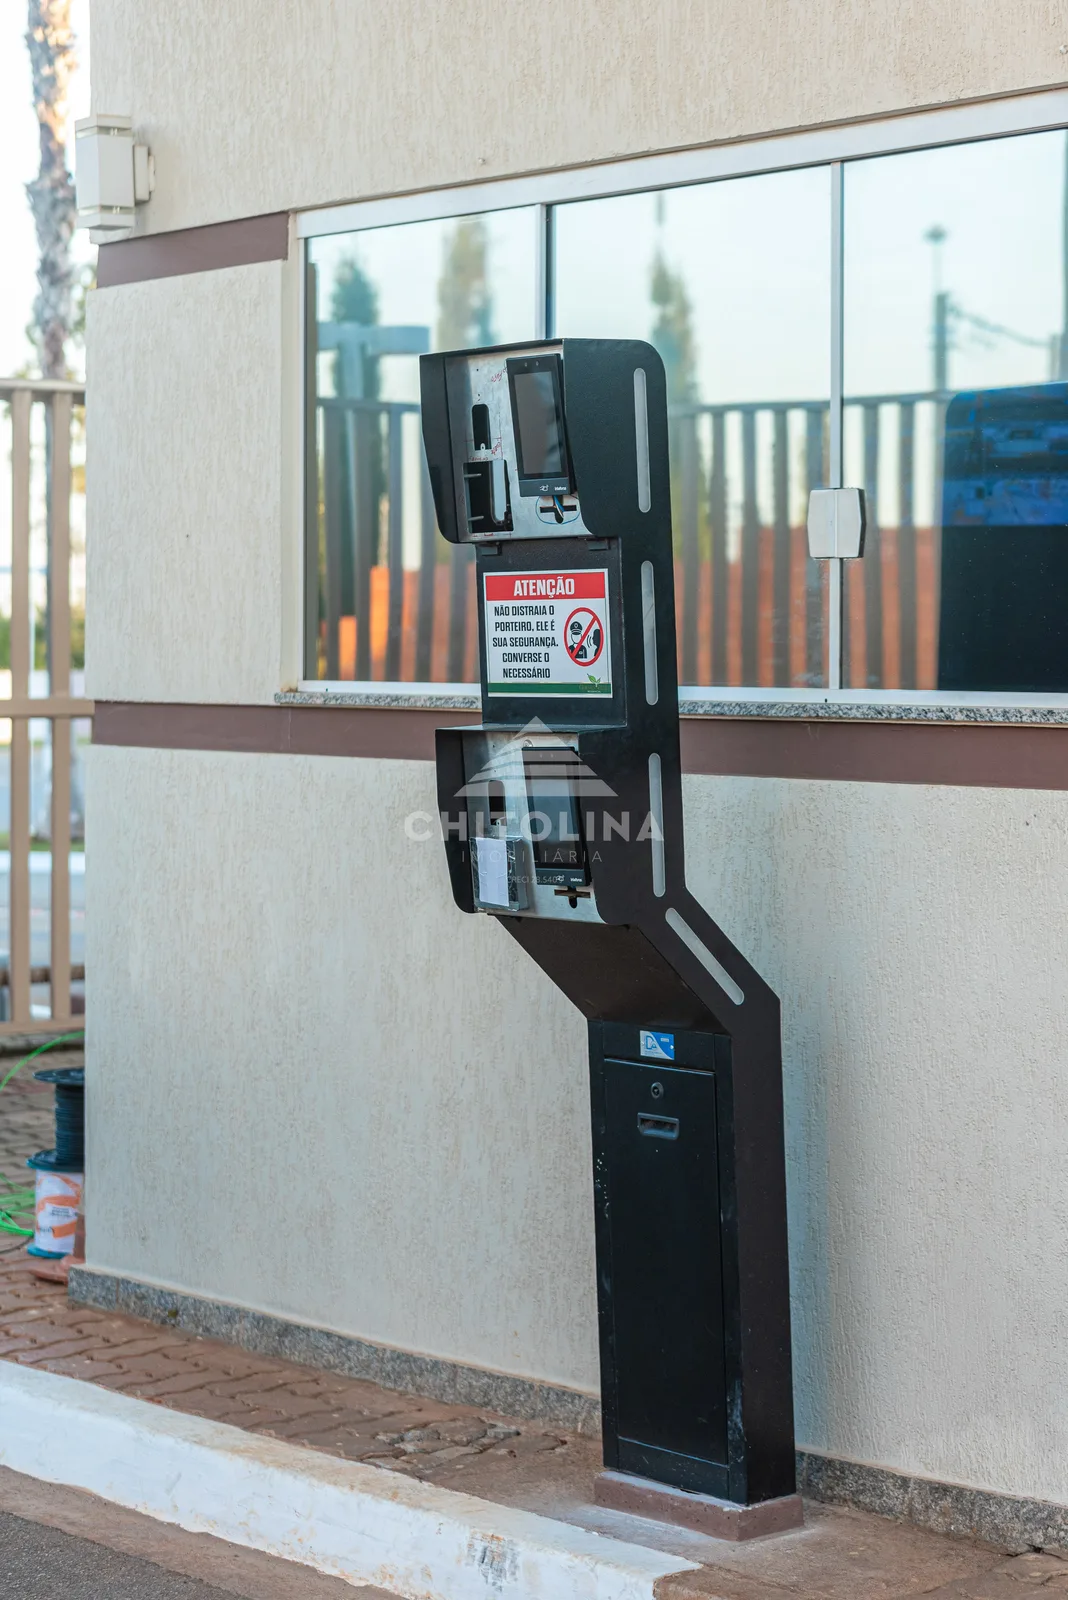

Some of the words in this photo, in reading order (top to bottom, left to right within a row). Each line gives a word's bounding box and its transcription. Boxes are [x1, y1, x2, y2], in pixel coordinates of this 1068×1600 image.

[514, 576, 575, 598] ATENÇÃO
[494, 605, 510, 617] NÃO
[511, 605, 547, 616] DISTRAIA
[549, 605, 555, 616] O
[536, 621, 549, 631] ELE
[551, 620, 556, 631] É
[492, 637, 508, 648] SUA
[509, 636, 559, 649] SEGURANÇA.
[502, 653, 542, 663] CONVERSE
[544, 653, 550, 662] O
[502, 667, 551, 679] NECESSÁRIO
